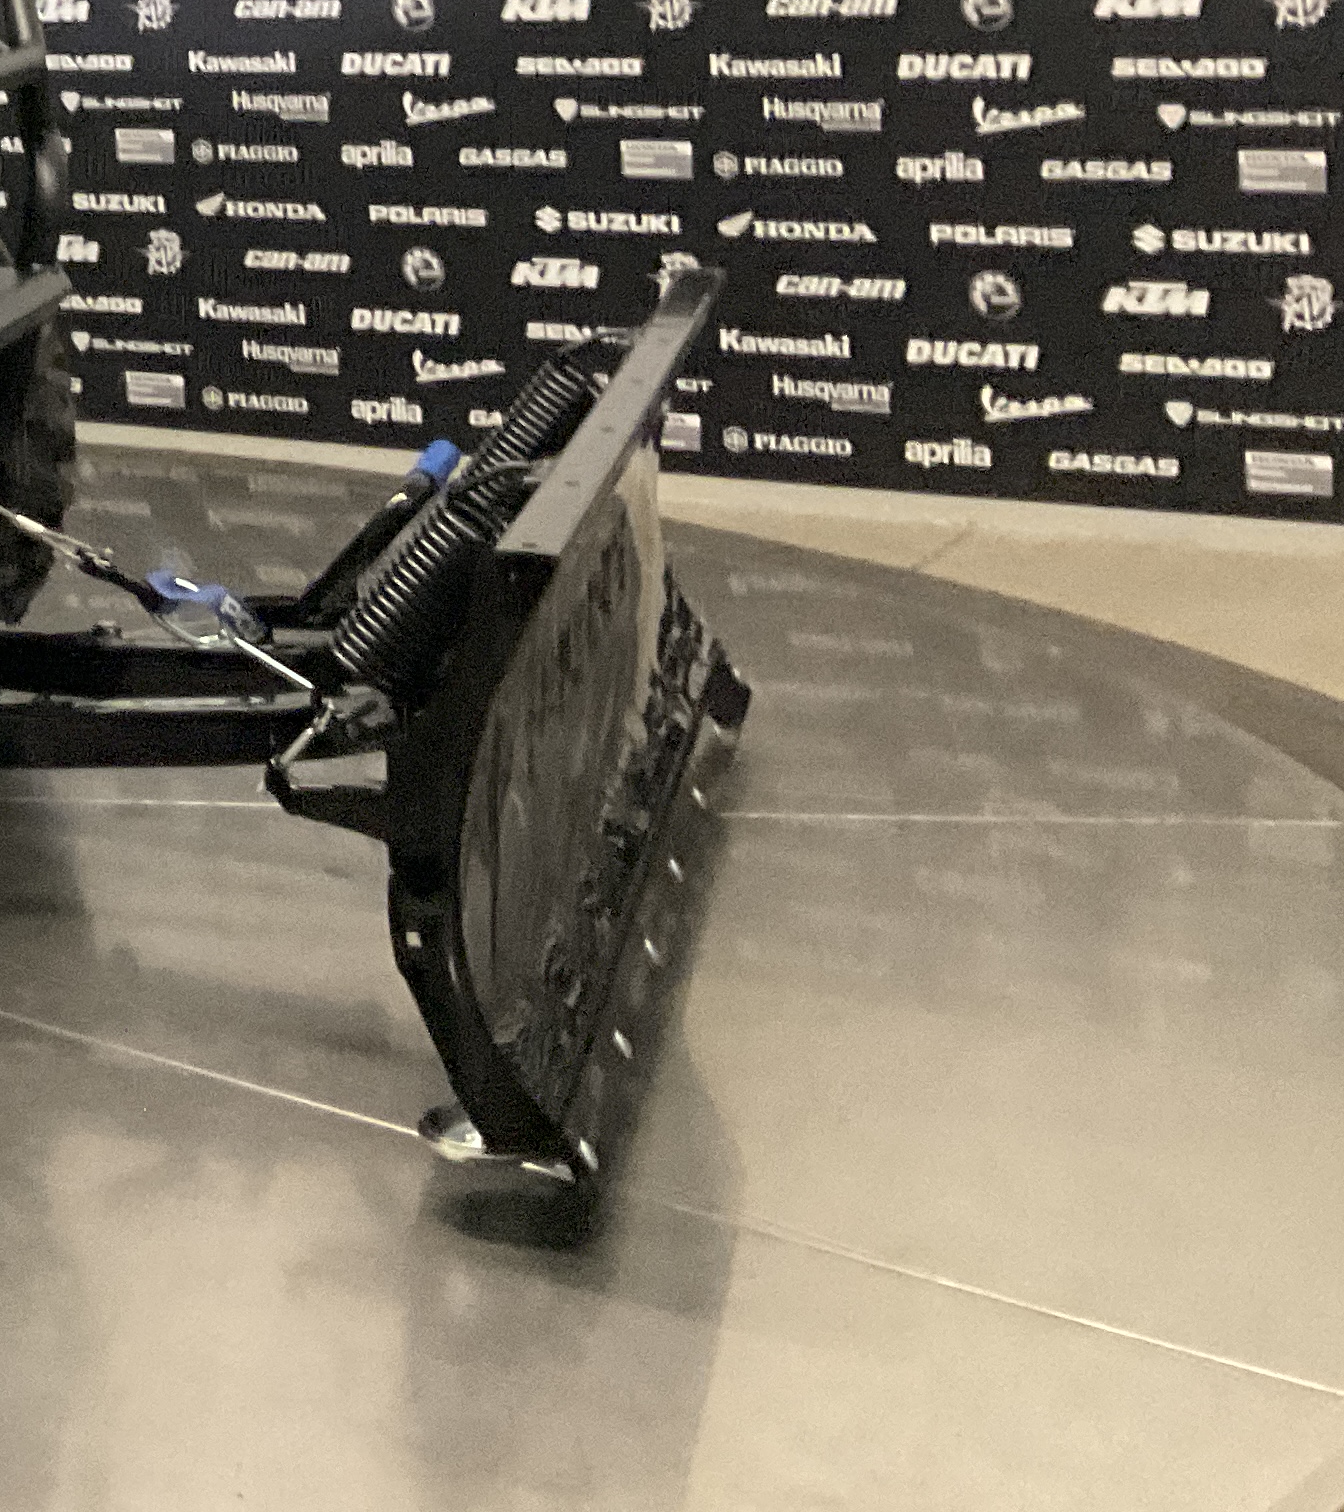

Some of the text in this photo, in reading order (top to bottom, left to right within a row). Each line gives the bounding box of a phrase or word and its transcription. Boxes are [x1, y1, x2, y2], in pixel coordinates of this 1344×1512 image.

[188, 51, 296, 72] Kawasaki
[341, 53, 450, 76] DUCATI
[710, 53, 841, 77] Kawasaki
[897, 54, 1031, 79] DUCATI
[218, 144, 298, 161] PIAGGIO
[341, 140, 413, 168] aprilia
[459, 148, 566, 167] GASGAS
[745, 157, 843, 176] PIAGGIO
[896, 152, 984, 184] aprilia
[1041, 160, 1171, 181] GASGAS
[73, 193, 165, 213] SUZUKI
[225, 201, 325, 220] HONDA
[369, 205, 486, 226] POLARIS
[568, 211, 680, 234] SUZUKI
[753, 221, 876, 242] HONDA
[930, 224, 1073, 247] POLARIS
[1172, 230, 1310, 254] SUZUKI
[511, 257, 599, 288] KTM
[1103, 281, 1209, 316] KTM
[198, 298, 306, 325] Kawasaki
[351, 308, 460, 335] DUCATI
[720, 329, 850, 358] Kawasaki
[907, 339, 1039, 370] DUCATI
[228, 393, 308, 413] PIAGGIO
[351, 397, 422, 424] aprilia
[754, 433, 852, 456] PIAGGIO
[905, 438, 991, 468] aprilia
[1049, 451, 1179, 477] GASGAS
